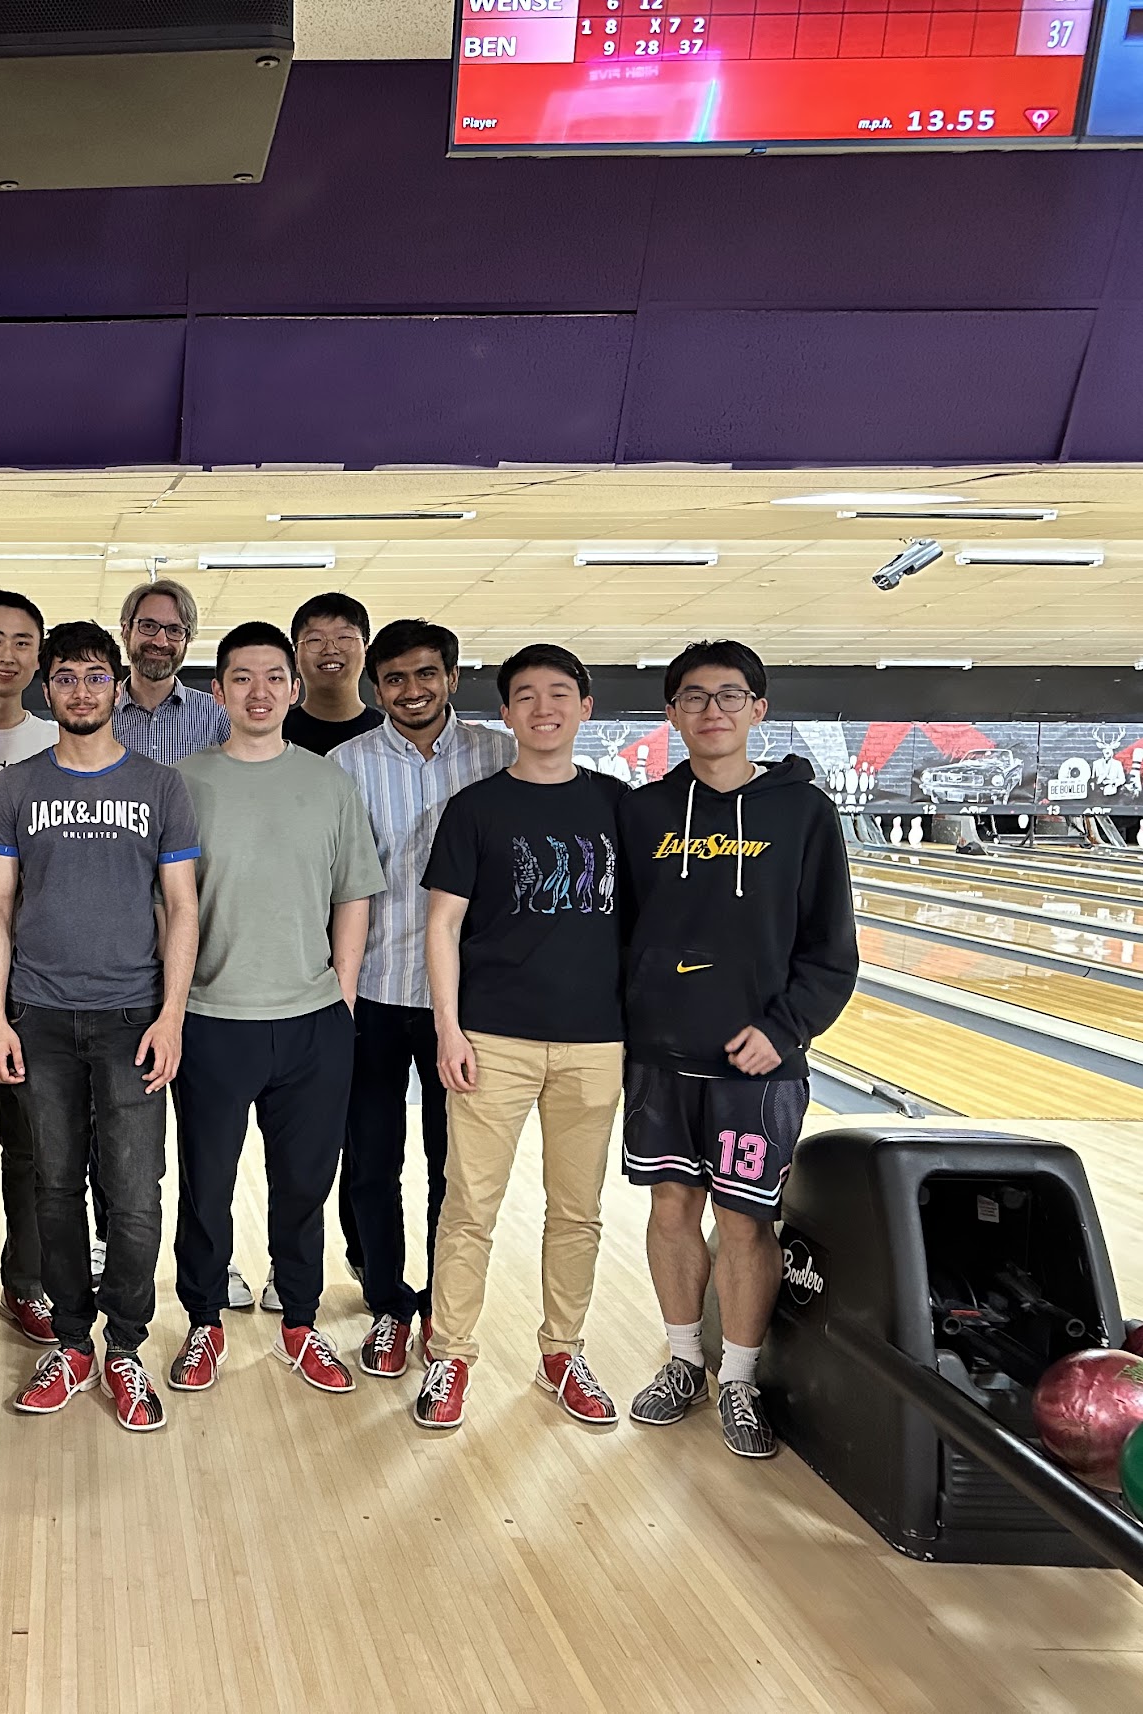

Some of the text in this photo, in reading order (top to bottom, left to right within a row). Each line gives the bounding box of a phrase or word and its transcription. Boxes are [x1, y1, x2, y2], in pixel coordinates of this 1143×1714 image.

[468, 0, 563, 13] WENSE
[580, 17, 706, 35] 1 8 X 7 2
[1047, 19, 1075, 49] 37
[464, 36, 704, 58] BEN 9 28 37
[462, 116, 498, 131] Player
[858, 109, 996, 131] m.p.h. 13.55
[1050, 785, 1059, 795] BE
[837, 805, 865, 814] AMF
[922, 804, 937, 815] 12
[959, 805, 989, 814] AMF
[1047, 805, 1061, 815] 13
[1082, 806, 1113, 815] AMF
[27, 799, 150, 838] JACK&JONES
[62, 831, 118, 839] UNLIMITED
[718, 1129, 767, 1181] 13
[782, 1248, 824, 1293] Bowlero
